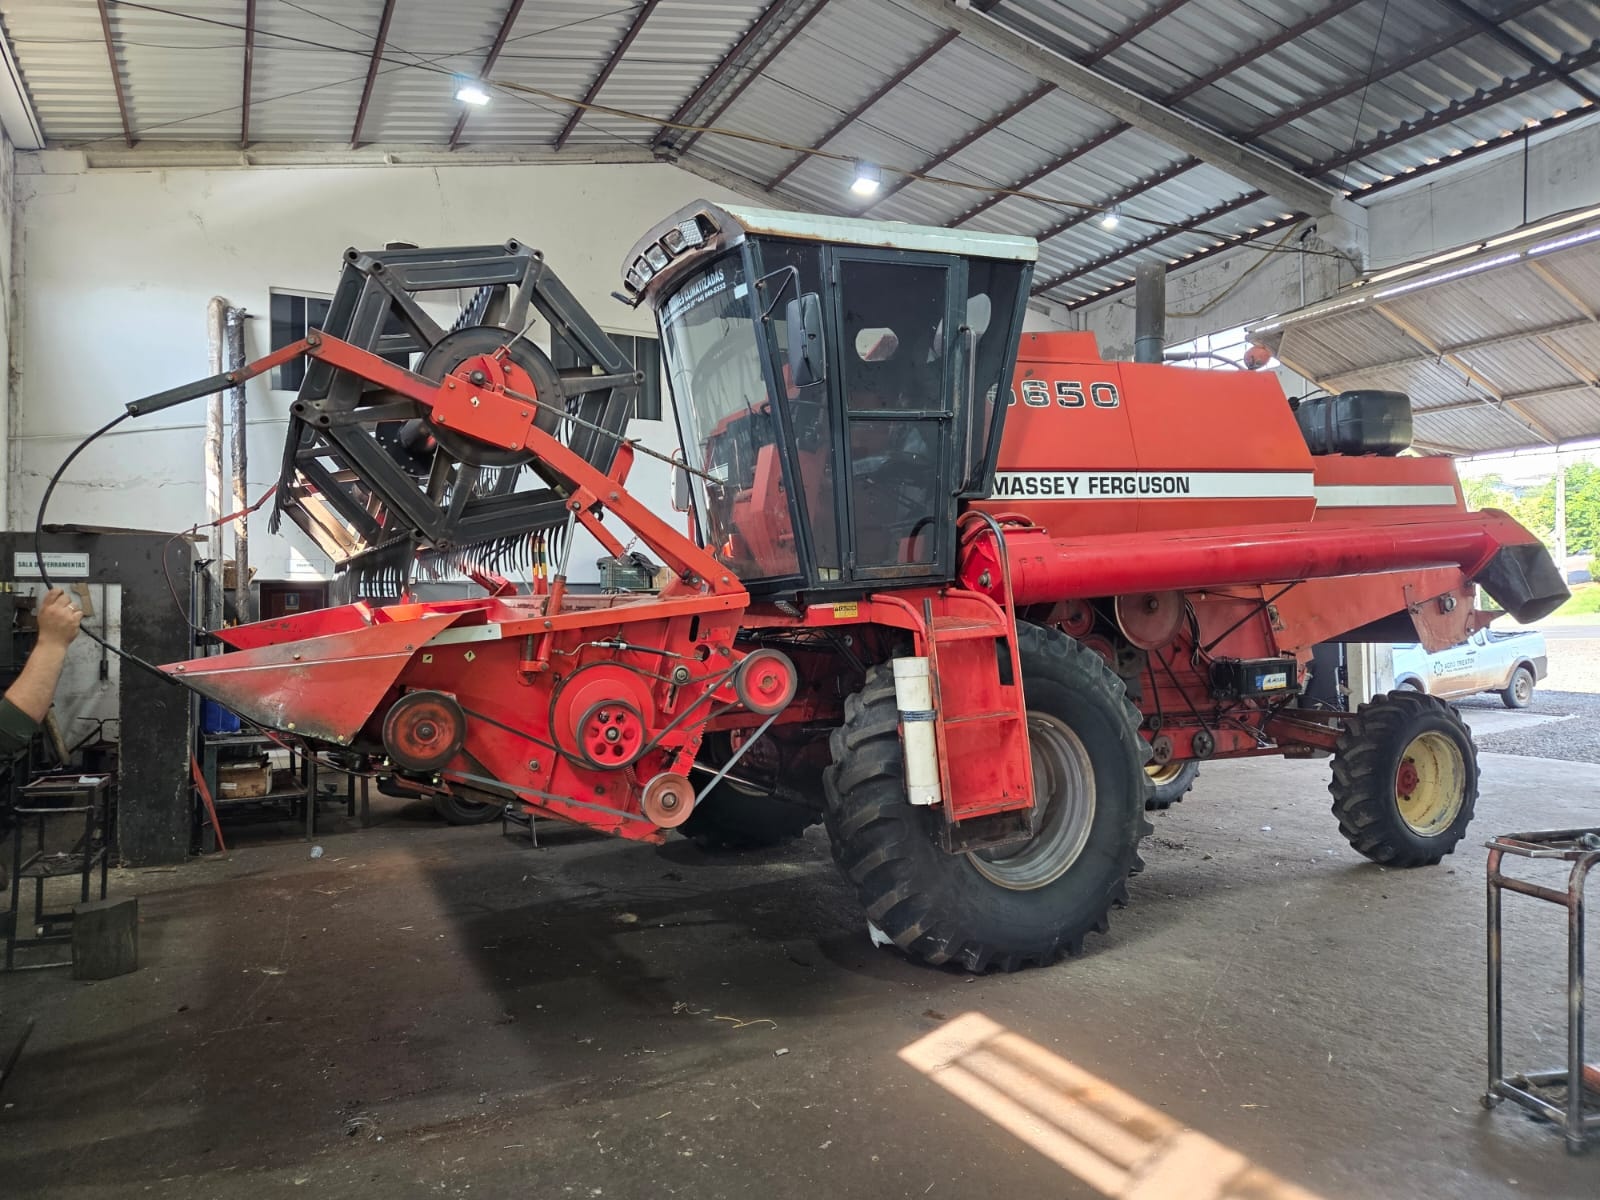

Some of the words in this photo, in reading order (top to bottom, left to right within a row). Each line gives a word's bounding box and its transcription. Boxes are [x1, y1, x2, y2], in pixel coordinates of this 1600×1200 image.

[684, 268, 724, 301] CLIMATIZADAS
[991, 476, 1079, 495] MASSEY
[1088, 476, 1190, 494] FERGUSON
